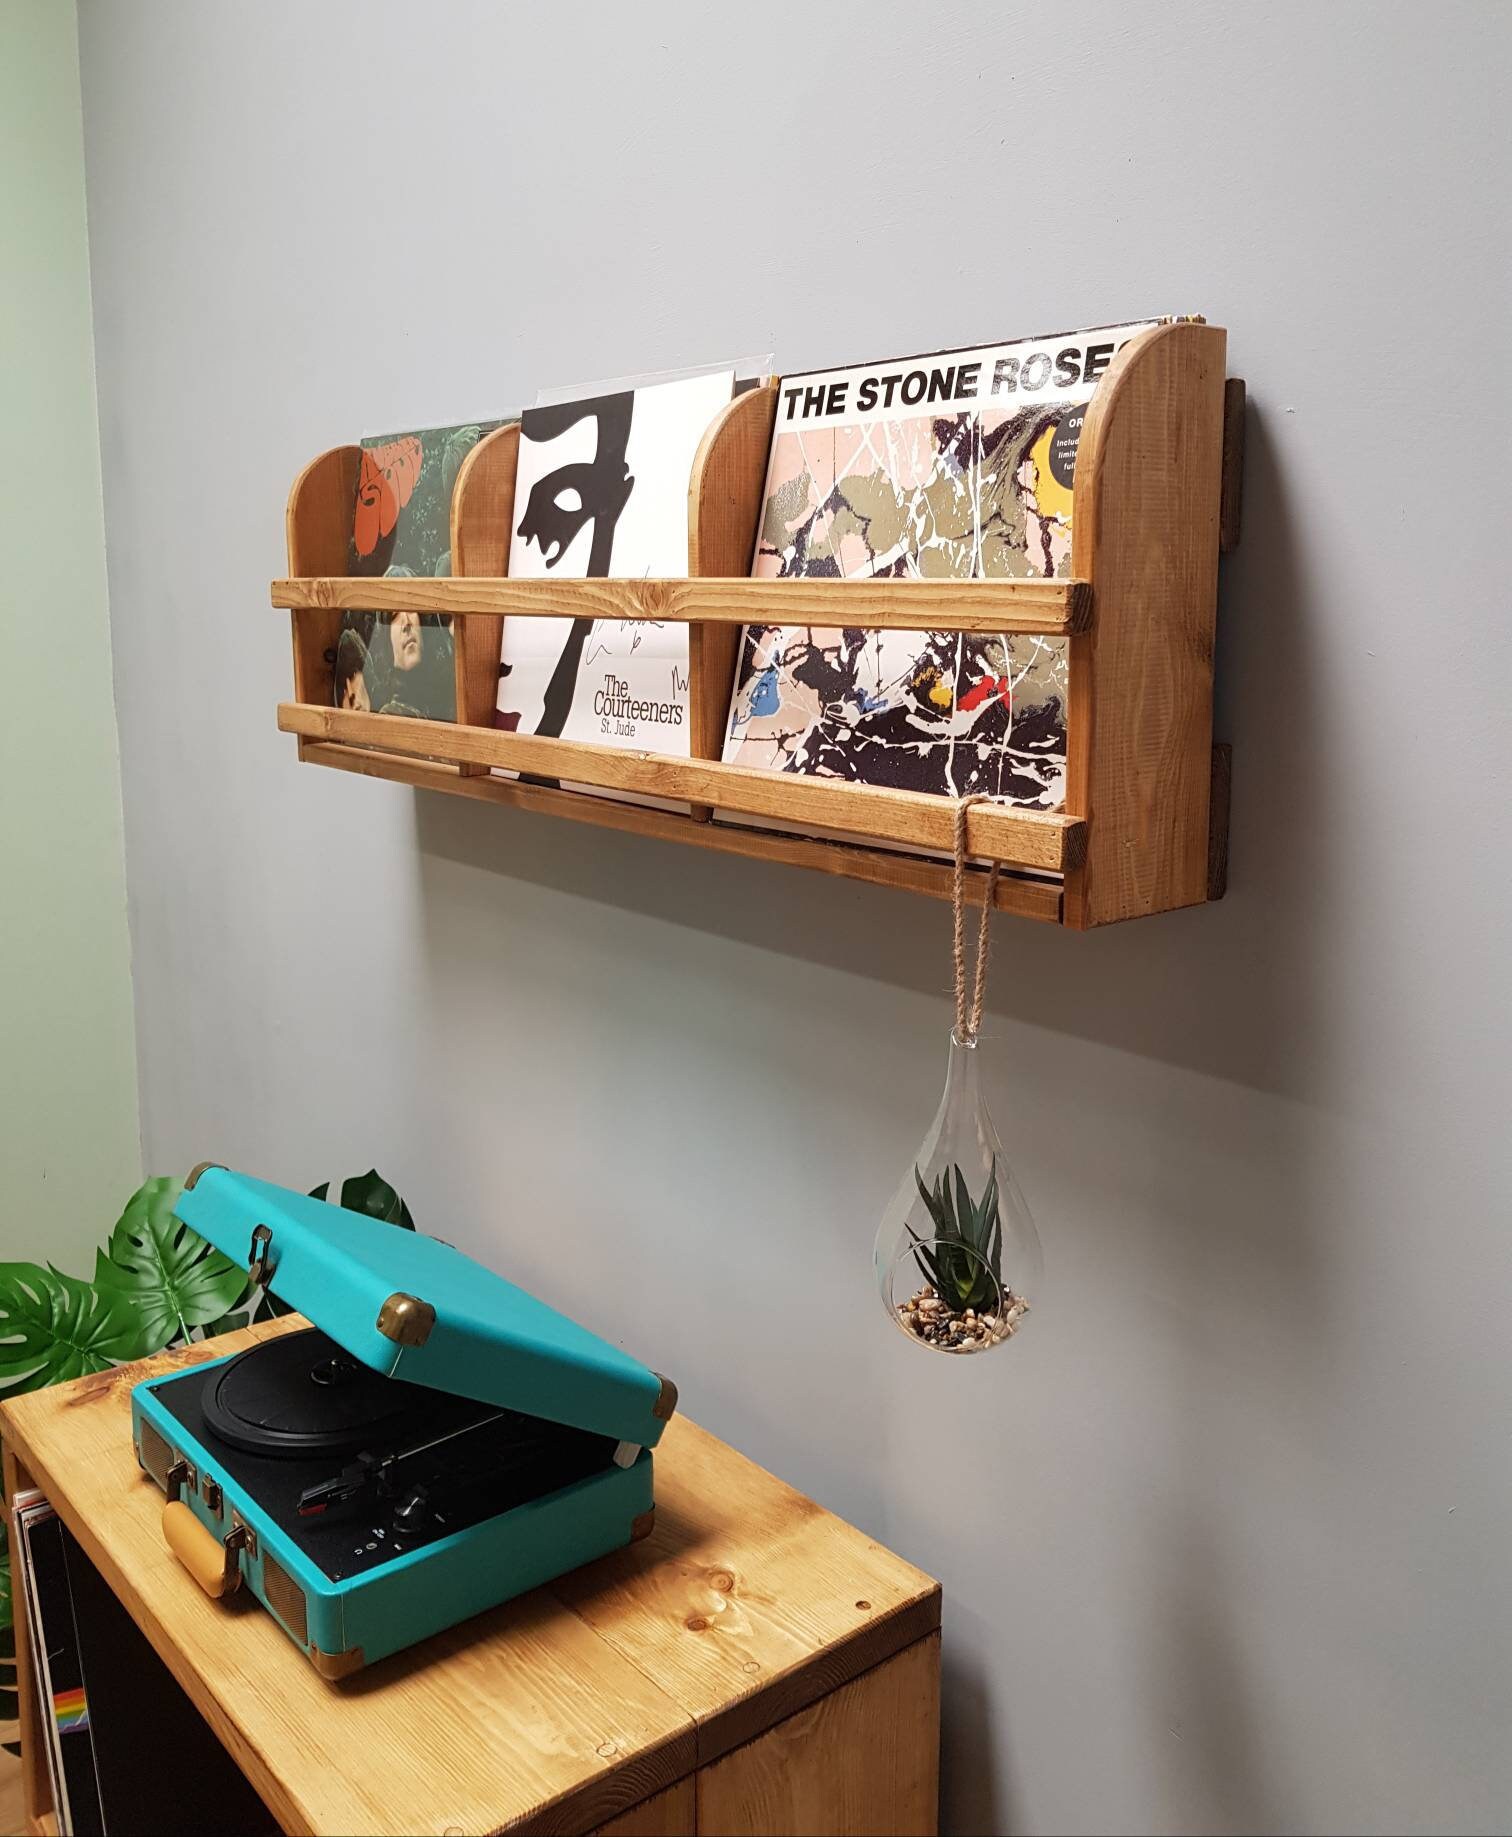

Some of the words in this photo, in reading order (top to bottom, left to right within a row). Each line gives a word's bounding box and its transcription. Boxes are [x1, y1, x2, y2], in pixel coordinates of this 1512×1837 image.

[784, 382, 849, 420] THE
[856, 363, 982, 411] STONE
[990, 338, 1131, 395] ROSE
[604, 674, 628, 698] The
[594, 690, 683, 725] Courteeners
[600, 717, 612, 734] St.
[614, 719, 636, 737] Jude
